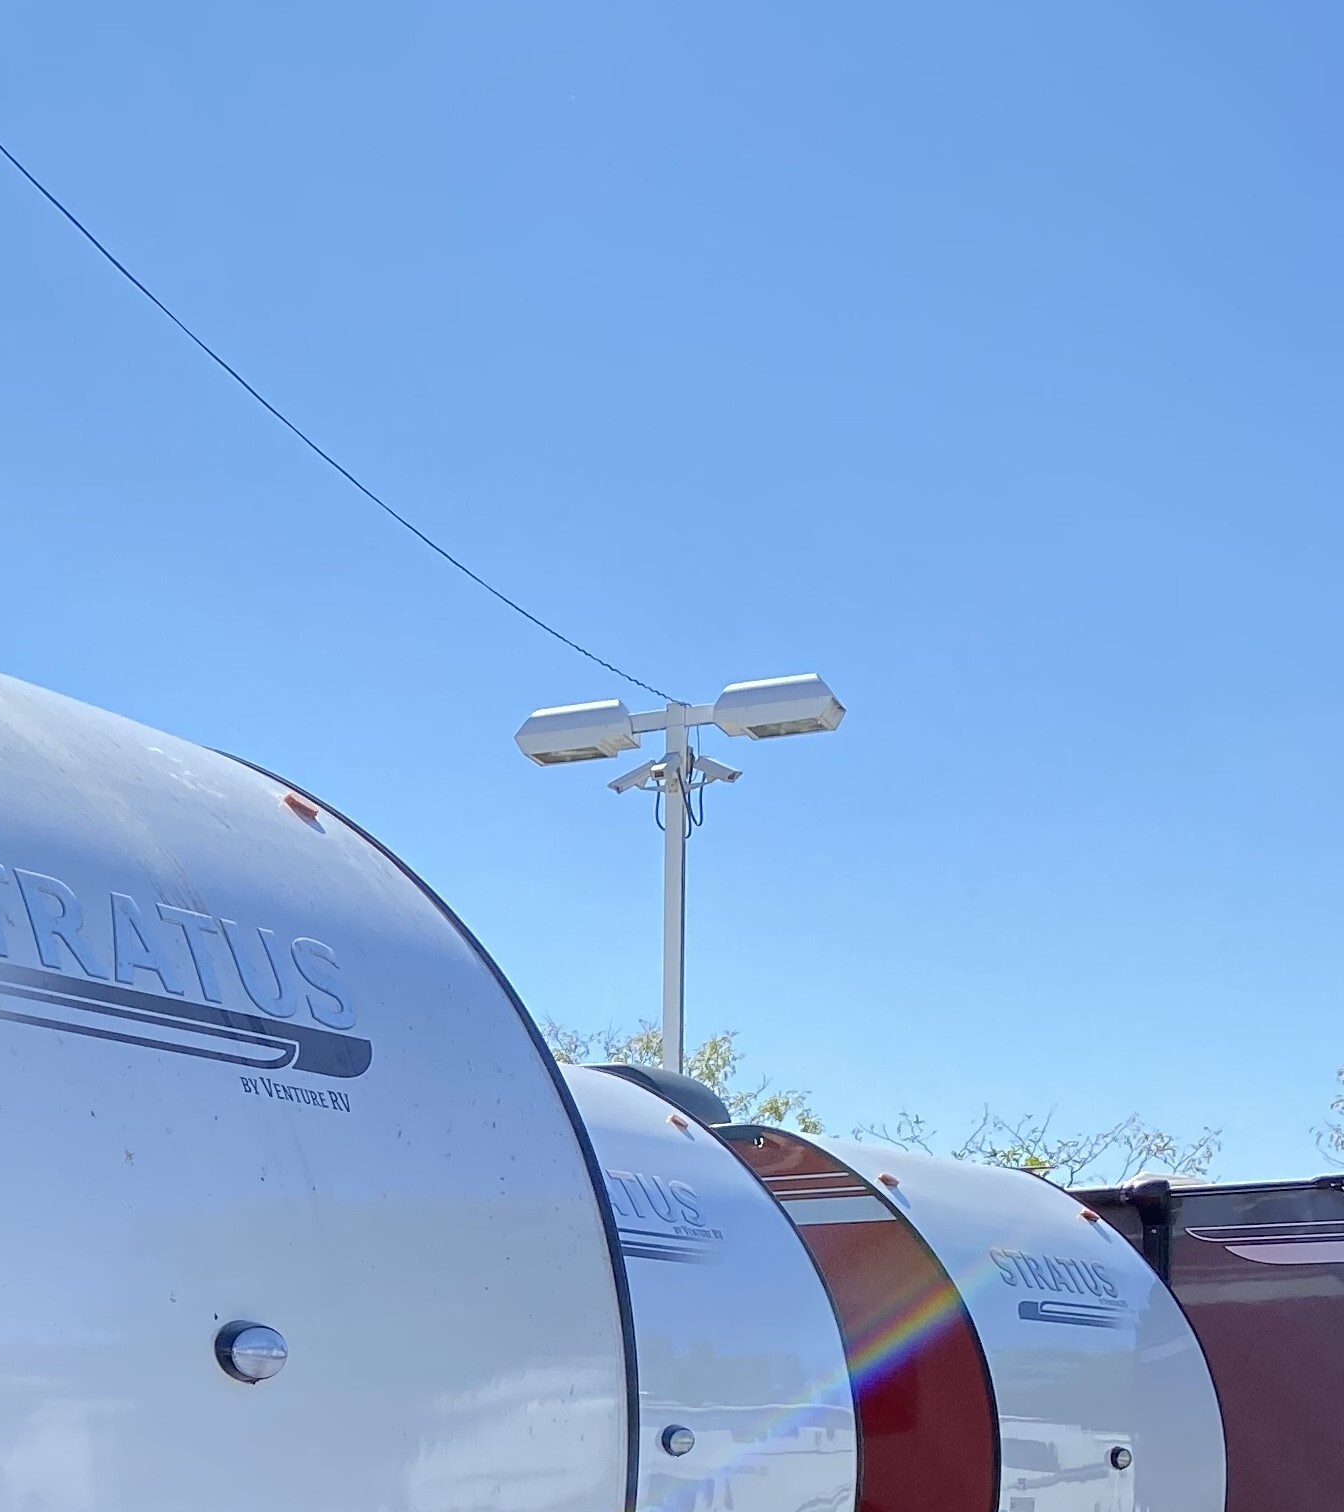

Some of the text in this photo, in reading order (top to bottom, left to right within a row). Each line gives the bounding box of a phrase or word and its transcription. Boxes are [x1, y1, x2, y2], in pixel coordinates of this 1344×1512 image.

[239, 1076, 260, 1096] BY
[327, 1089, 351, 1113] RV
[989, 1247, 1119, 1299] STRATUS
